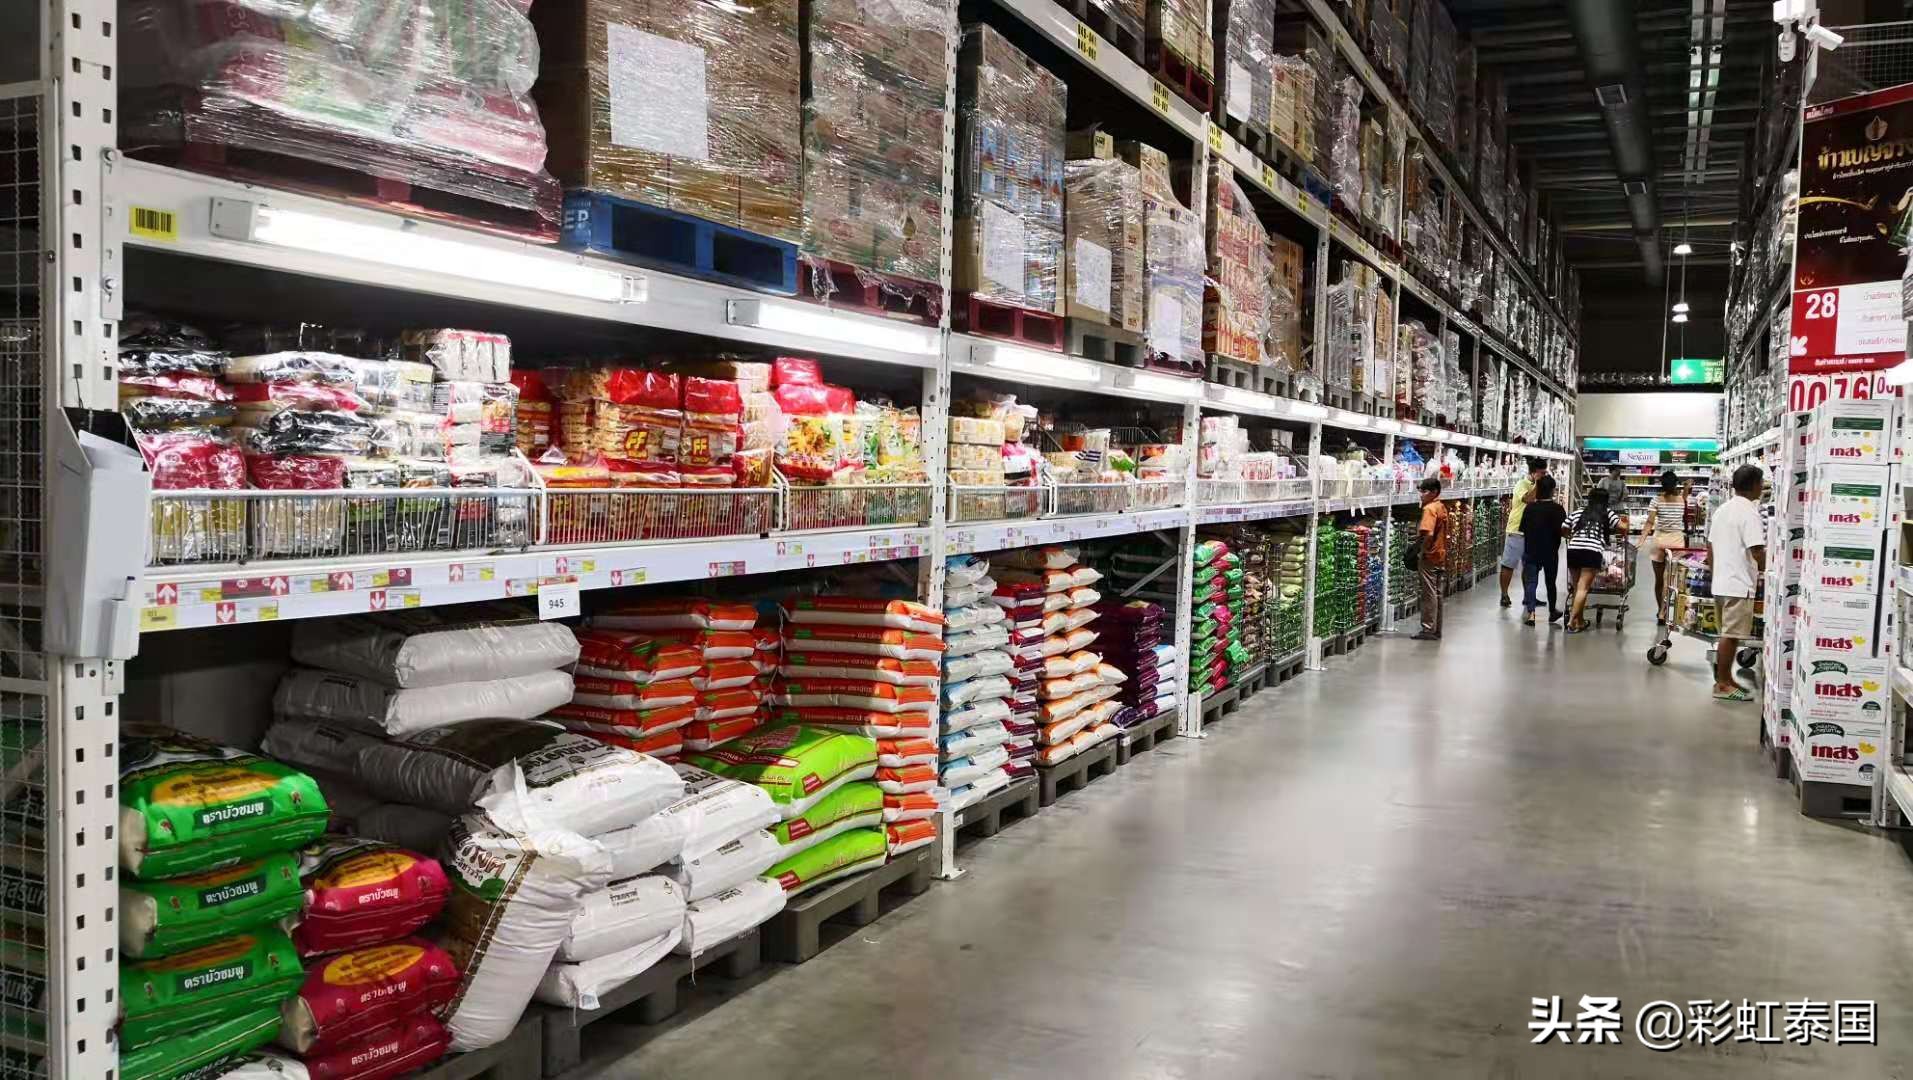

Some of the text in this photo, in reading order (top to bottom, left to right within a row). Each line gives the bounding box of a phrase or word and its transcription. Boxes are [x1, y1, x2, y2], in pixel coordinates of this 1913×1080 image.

[1805, 292, 1836, 319] 28
[549, 599, 565, 609] 945
[202, 801, 264, 825] ตราบัวชมพู
[184, 965, 244, 990] ตราบัวชมพู
